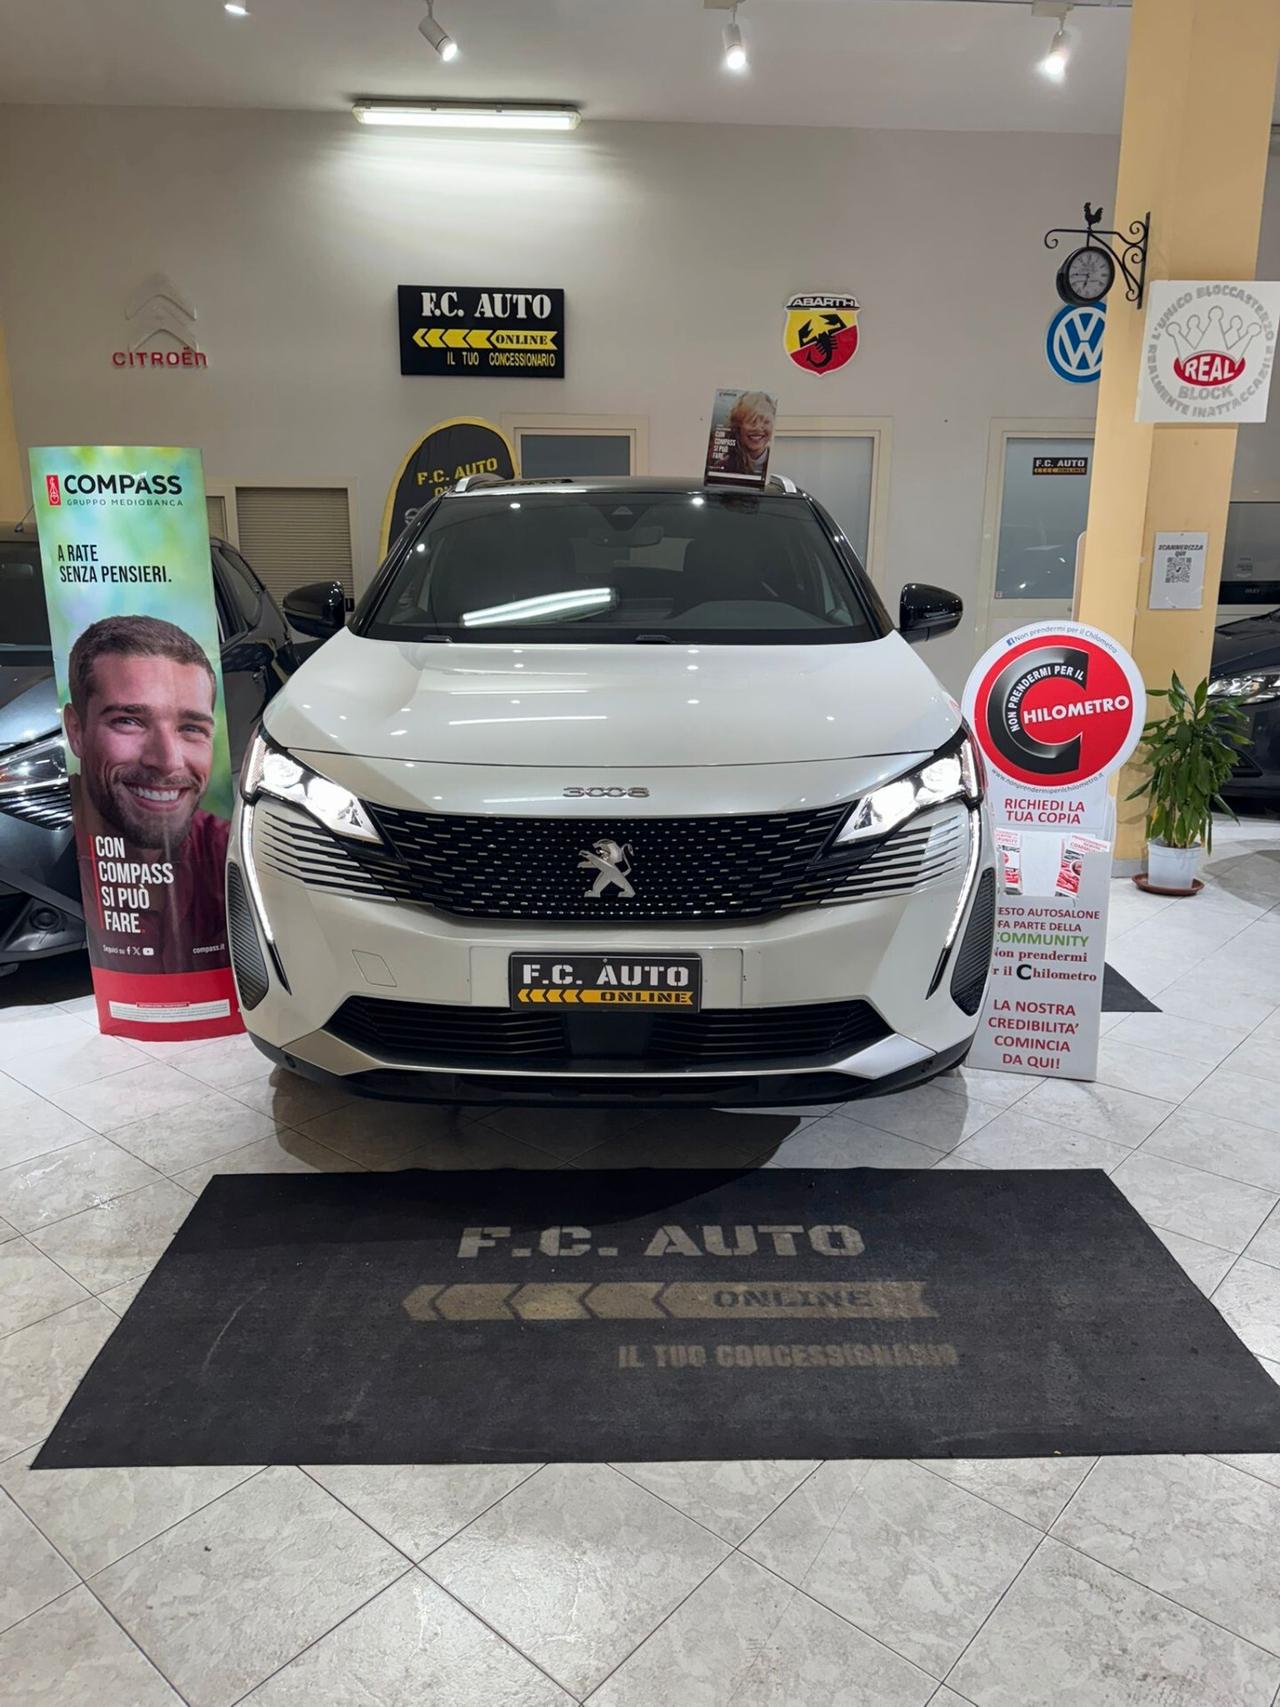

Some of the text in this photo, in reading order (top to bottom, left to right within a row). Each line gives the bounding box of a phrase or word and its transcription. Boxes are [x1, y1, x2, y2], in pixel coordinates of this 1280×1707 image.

[421, 291, 552, 319] F.C. AUTO
[792, 297, 854, 307] ABARTH
[495, 333, 548, 346] ONLINE
[447, 351, 556, 367] IL TUO CONCESSIONARIO
[1184, 355, 1235, 382] REAL
[1178, 384, 1235, 401] BLOCK
[416, 457, 498, 486] F.C. AUTO
[1035, 459, 1085, 467] F.C. AUTO
[64, 474, 183, 495] COMPASS
[111, 499, 184, 507] MEDIOBANCA
[57, 544, 99, 562] A RATE
[59, 565, 172, 583] SENZA PENSIERI.
[1014, 631, 1030, 643] Non
[1029, 626, 1066, 638] prendermi
[1066, 626, 1078, 634] per
[1084, 630, 1118, 654] Chilometro
[1007, 665, 1085, 733] NON PRENDERMI PER IL
[562, 786, 650, 798] 3008
[1004, 798, 1085, 812] RICHIEDI LA
[1006, 810, 1081, 824] TUA COPIA
[95, 835, 126, 859] CON
[98, 861, 175, 884] COMPASS
[101, 883, 150, 909] SI PUÒ
[998, 906, 1101, 920] ESTO AUTOSALONE
[997, 919, 1082, 933] FA PARTE DELLA
[997, 931, 1089, 947] OMMUNITY
[192, 943, 226, 954] compass.it
[1018, 950, 1088, 962] prendermi
[522, 964, 689, 987] F.C. AUTO
[1003, 966, 1012, 976] il
[1016, 964, 1097, 982] Chilometro
[600, 991, 688, 1003] ONLINE
[993, 999, 1076, 1016] LA NOSTRA
[994, 1035, 1071, 1053] COMINCIA
[1002, 1053, 1060, 1069] DA QUI!
[457, 1225, 866, 1258] F.C. AUTO
[713, 1289, 876, 1308] ONLINE
[618, 1345, 645, 1368] IL
[653, 1345, 706, 1368] TUO
